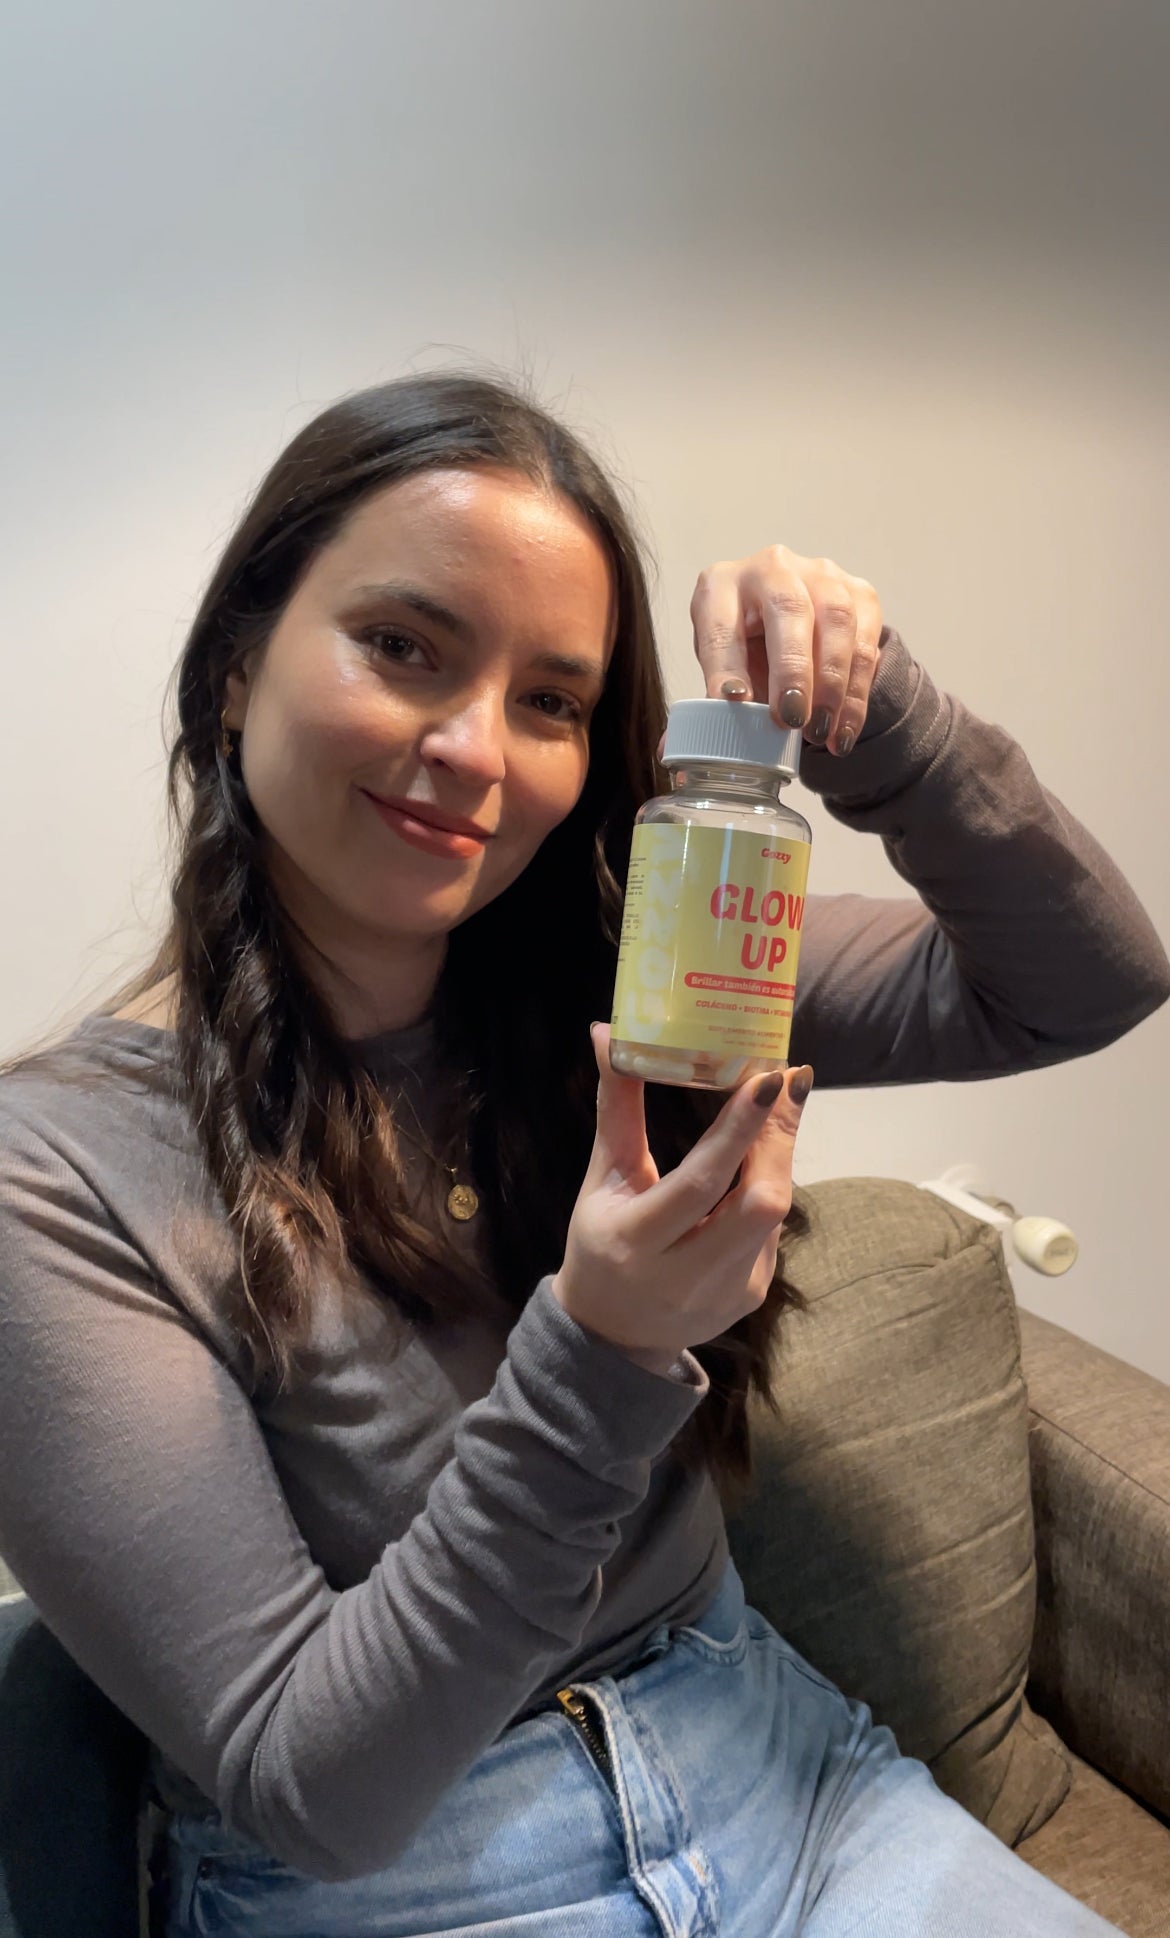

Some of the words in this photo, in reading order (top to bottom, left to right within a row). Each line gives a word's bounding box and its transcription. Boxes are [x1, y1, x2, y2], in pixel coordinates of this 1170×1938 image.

[761, 848, 791, 864] Gozzy
[710, 884, 805, 931] GLOW
[741, 933, 787, 972] UP
[691, 976, 723, 987] Brillar
[724, 980, 760, 992] también
